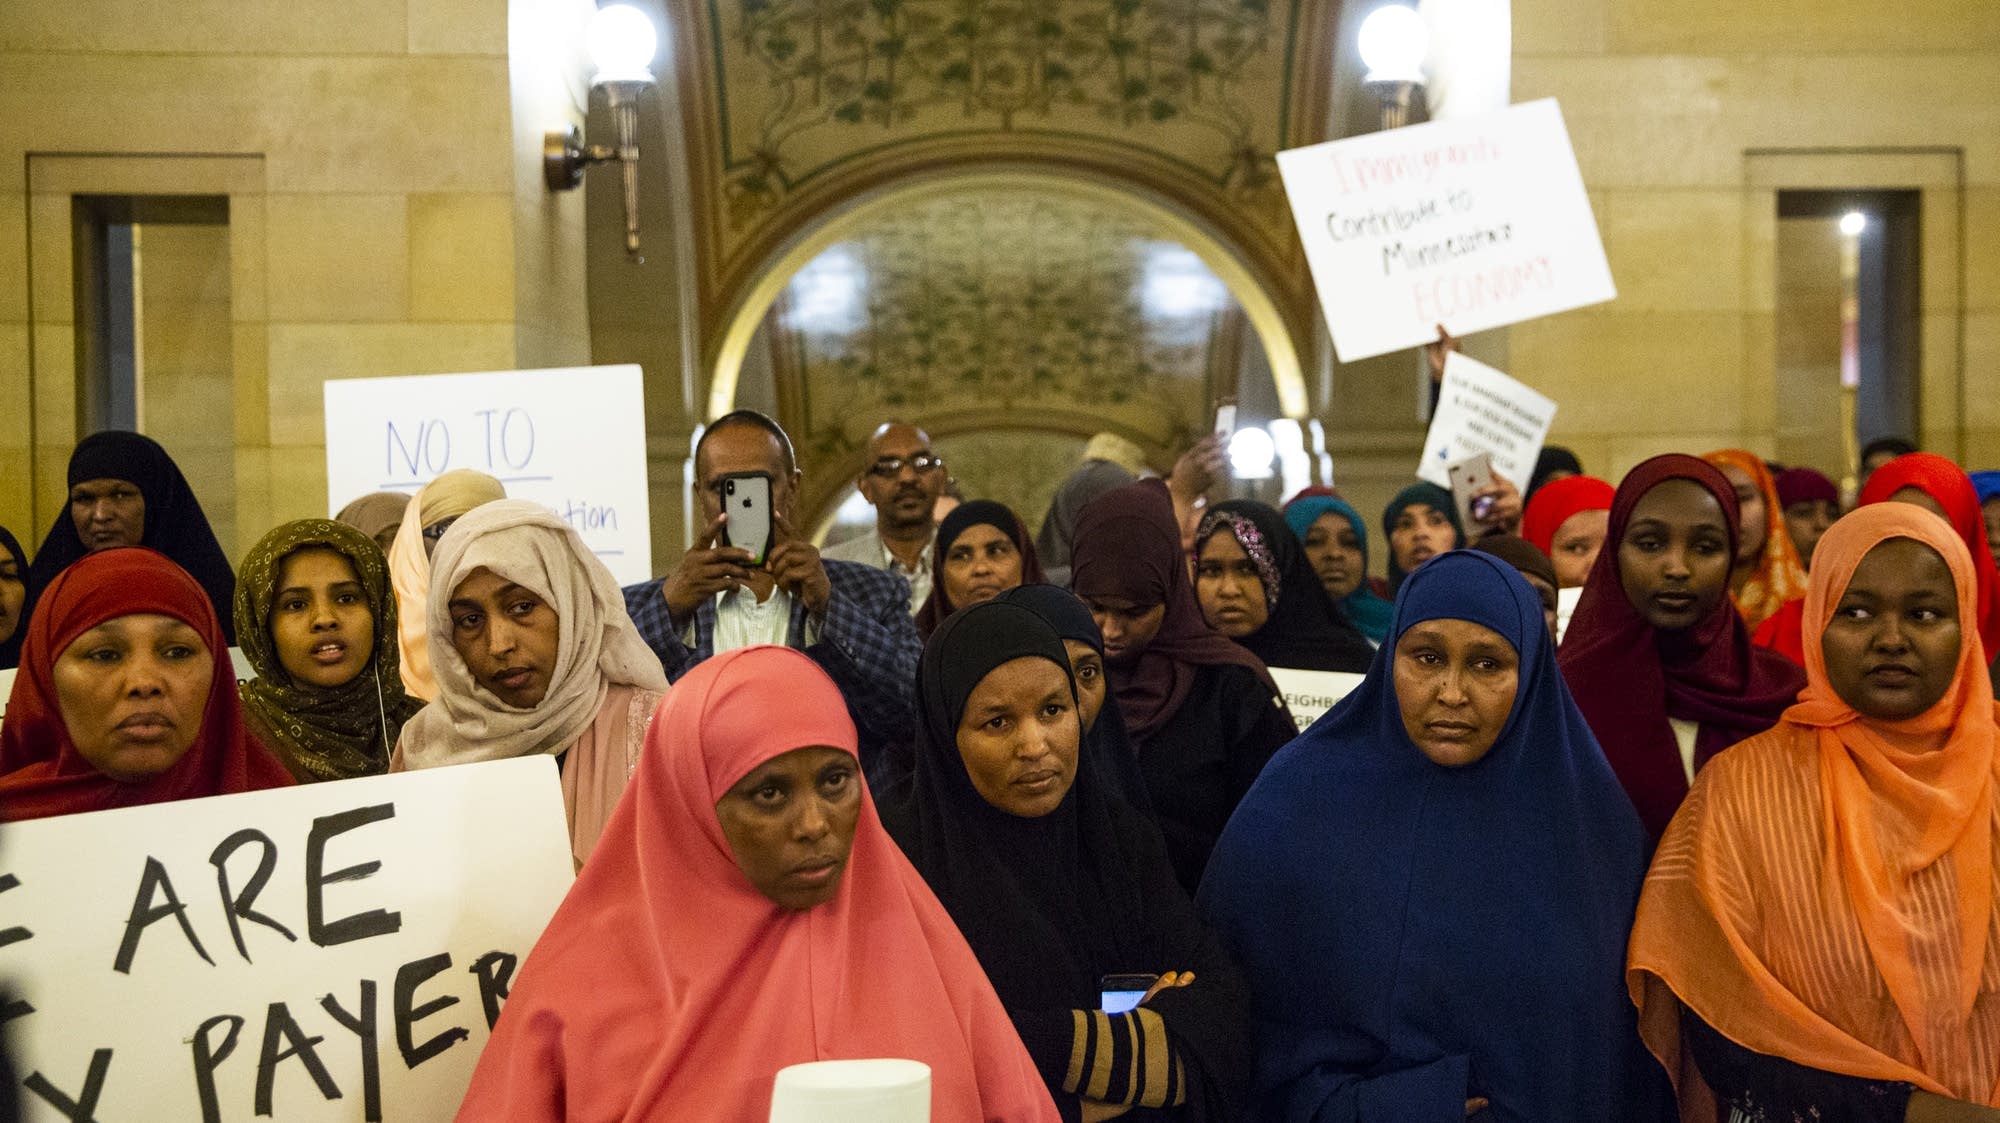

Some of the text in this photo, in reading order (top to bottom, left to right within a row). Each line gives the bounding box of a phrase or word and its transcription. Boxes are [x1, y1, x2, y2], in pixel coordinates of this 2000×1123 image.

[1327, 188, 1473, 241] Contribute to
[1413, 256, 1553, 322] ECONOMY
[387, 407, 534, 476] NO TO
[558, 497, 618, 531] tion
[1284, 693, 1340, 709] EIGHB
[113, 802, 402, 975] ARE
